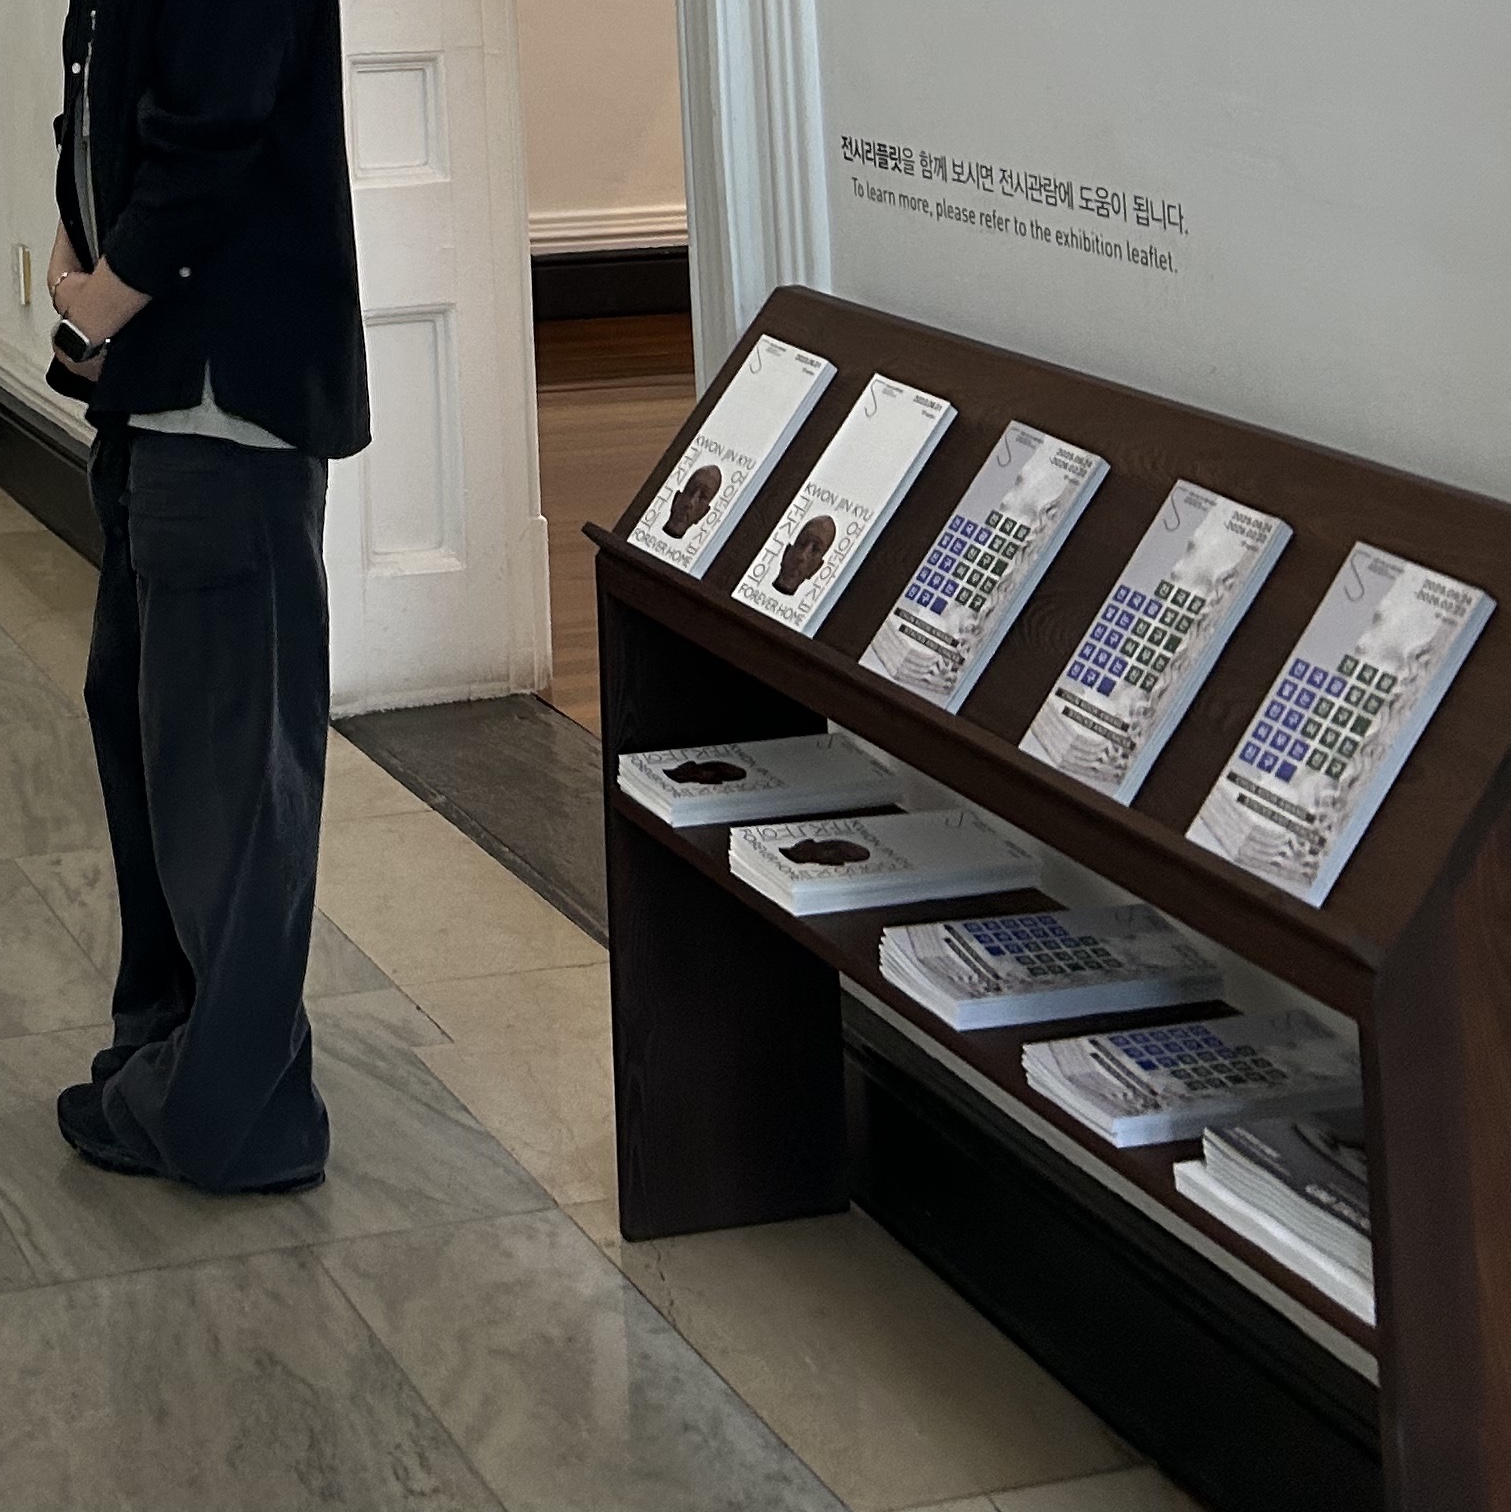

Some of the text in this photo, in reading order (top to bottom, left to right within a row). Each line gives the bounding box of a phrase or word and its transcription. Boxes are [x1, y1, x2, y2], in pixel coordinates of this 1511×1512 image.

[840, 135, 1190, 236] 전시리플릿을 함께 보시면 전시관람에 도움이 됩니다.
[851, 176, 1180, 275] To learn more, please refer to the exhibition leaflet.
[804, 482, 838, 506] KWON
[853, 503, 875, 522] KYU
[738, 582, 807, 627] FOREVER HOME
